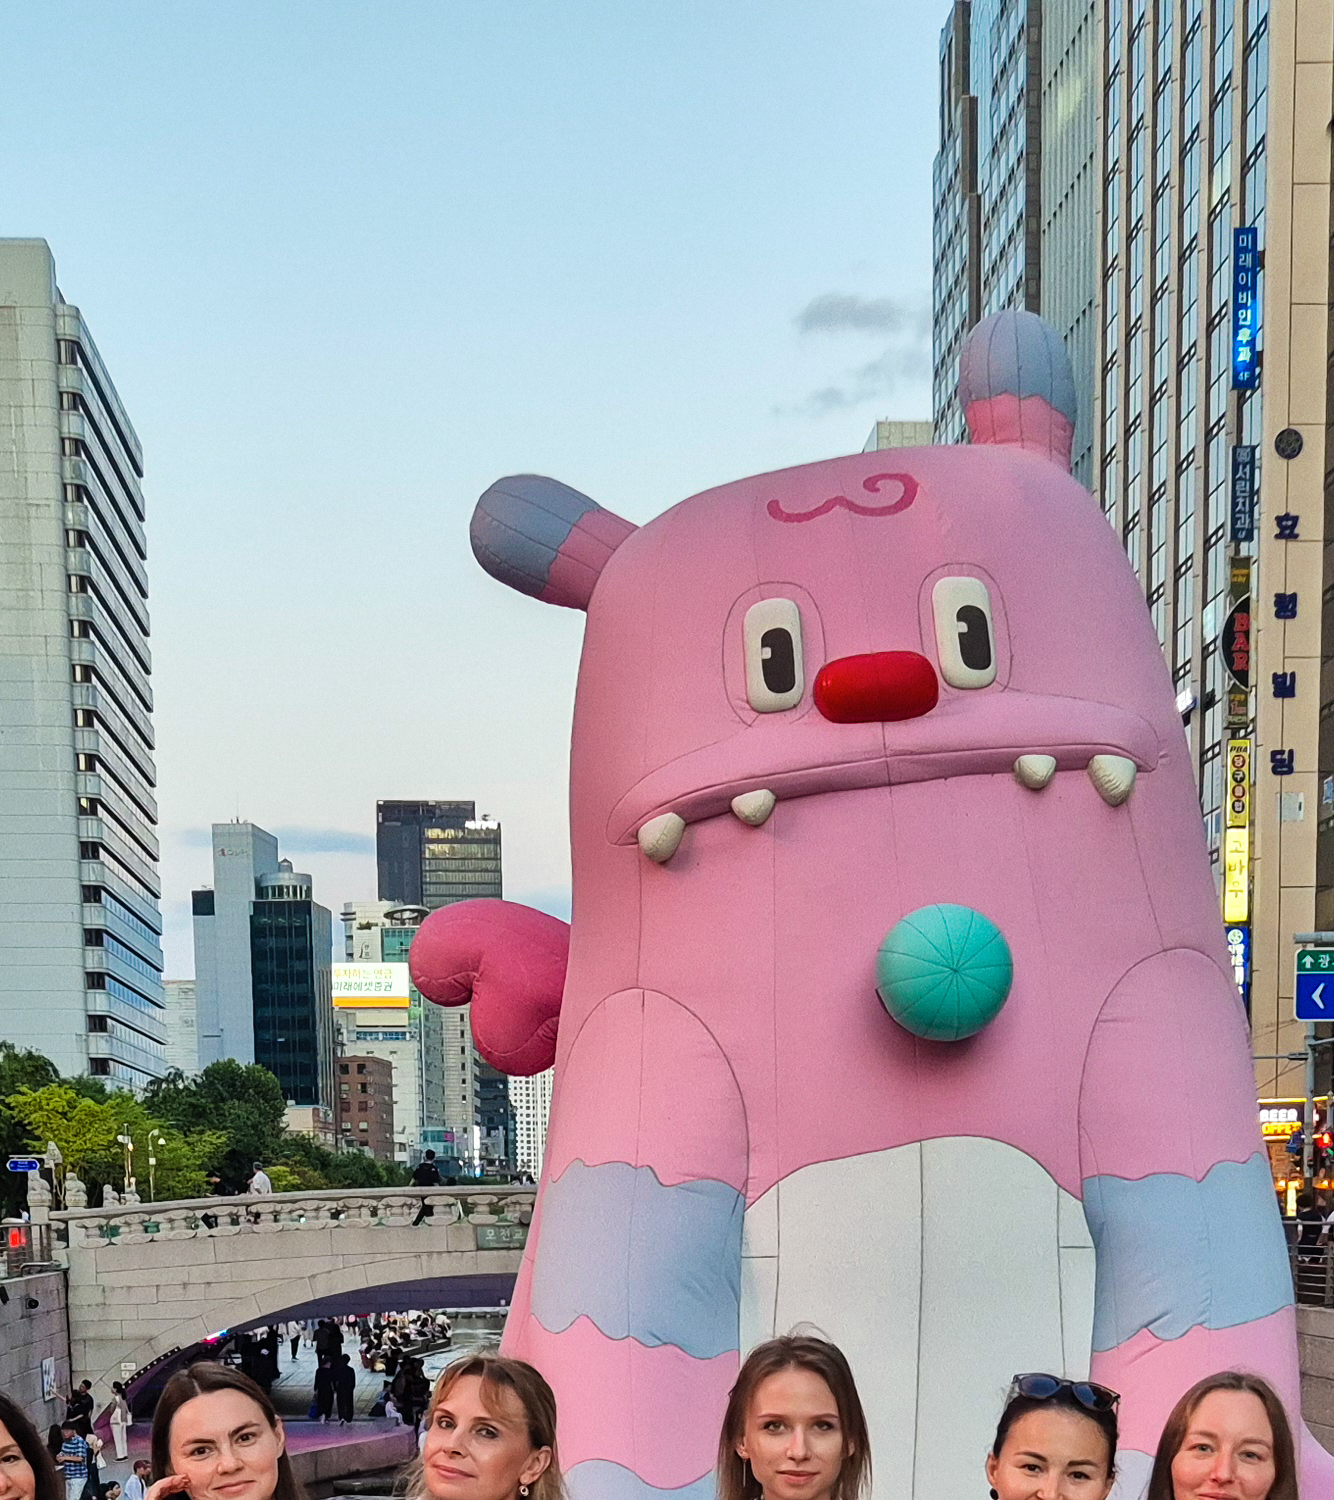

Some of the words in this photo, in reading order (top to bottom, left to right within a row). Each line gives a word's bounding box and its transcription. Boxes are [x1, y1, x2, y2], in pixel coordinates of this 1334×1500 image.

[1236, 233, 1252, 363] 미래이비인후과
[1237, 371, 1251, 381] 4F
[1231, 613, 1250, 671] BAR
[334, 969, 371, 979] 투자하는
[374, 969, 392, 979] 연금
[334, 981, 393, 992] 미래에셋증권
[1259, 1109, 1298, 1122] BEER
